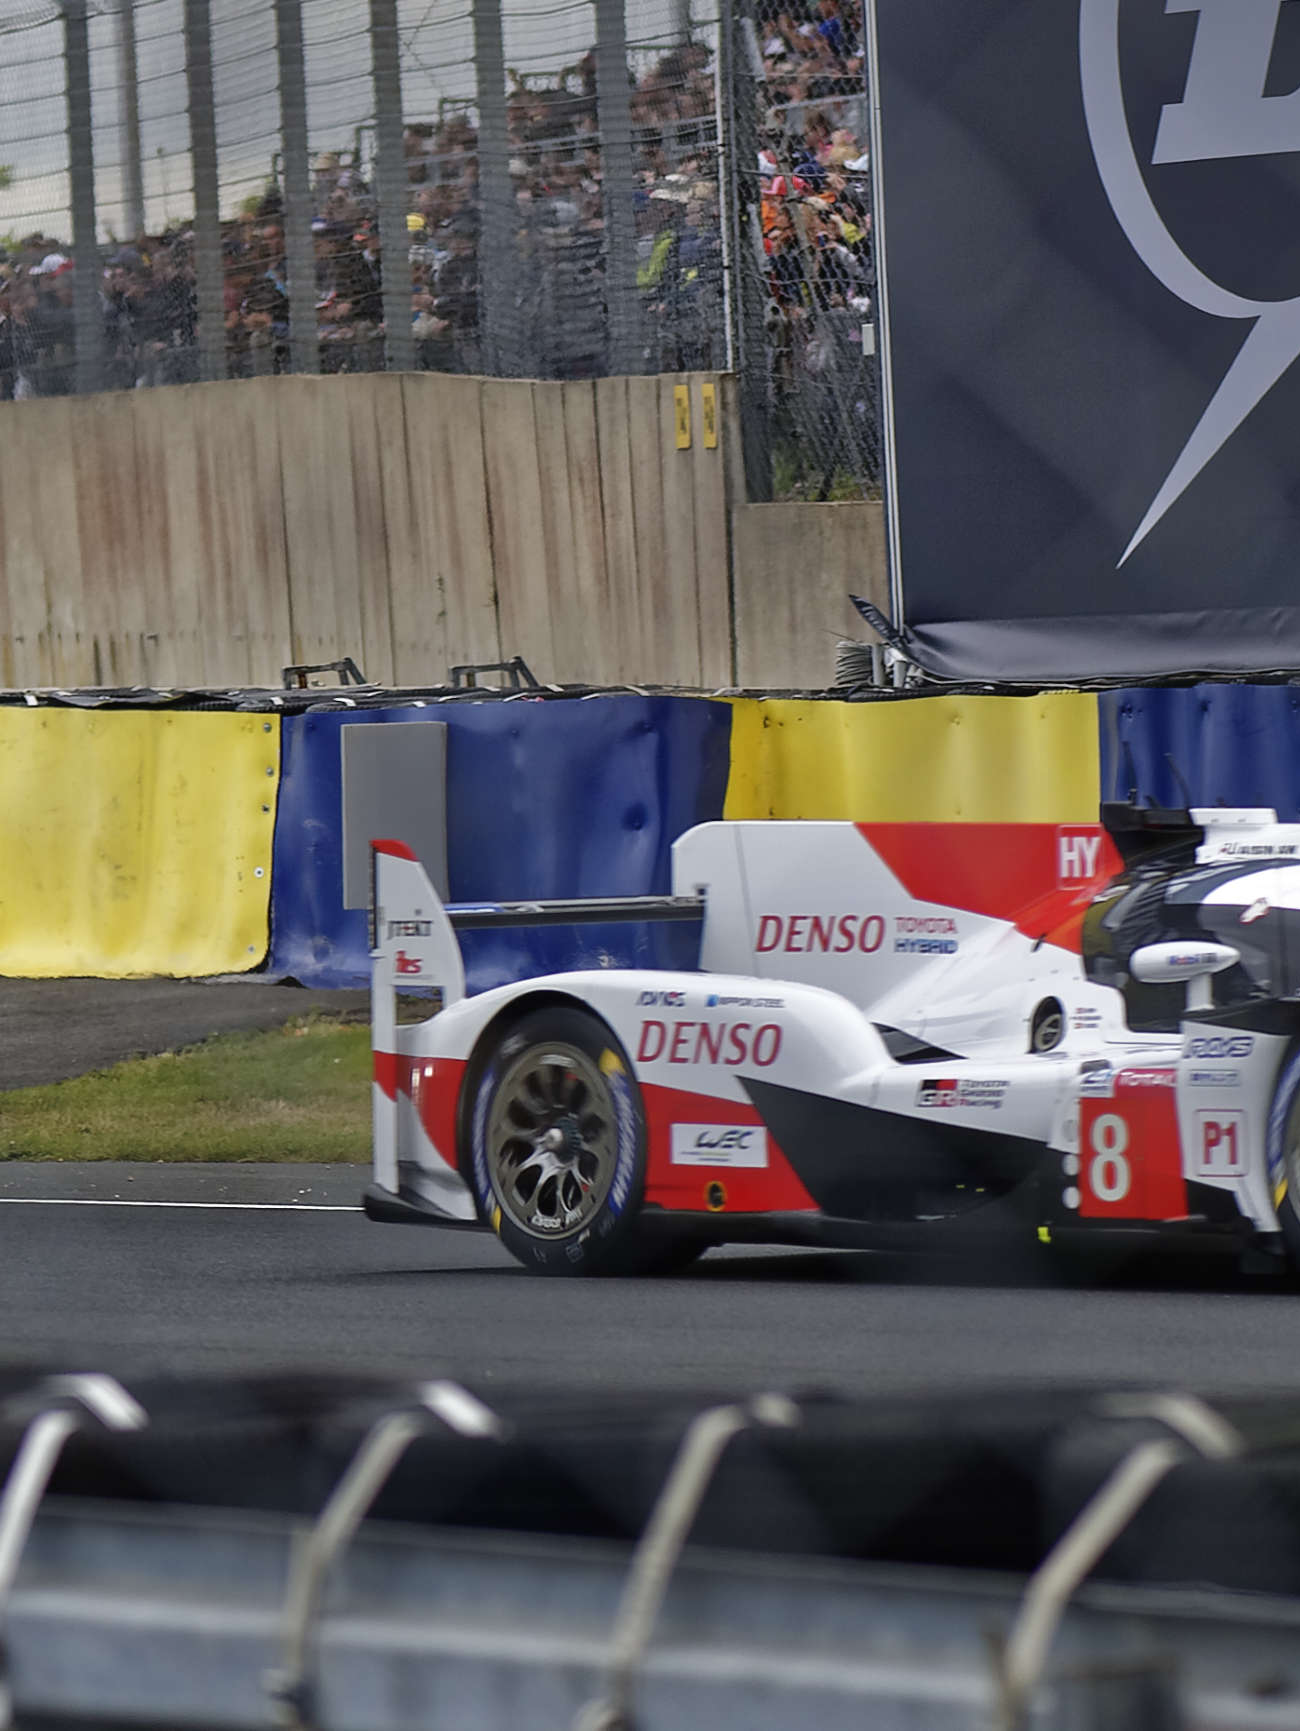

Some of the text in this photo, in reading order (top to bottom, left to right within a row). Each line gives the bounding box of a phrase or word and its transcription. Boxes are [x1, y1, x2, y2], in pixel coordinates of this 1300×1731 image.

[1058, 835, 1100, 879] HY
[755, 914, 887, 953] DENSO
[894, 916, 959, 935] TOYOTA
[894, 938, 960, 954] HYBRID
[636, 1020, 784, 1067] DENSO
[1182, 1036, 1254, 1059] RAYS
[694, 1129, 756, 1150] WEC
[1089, 1113, 1132, 1202] 8
[1203, 1121, 1239, 1166] P1
